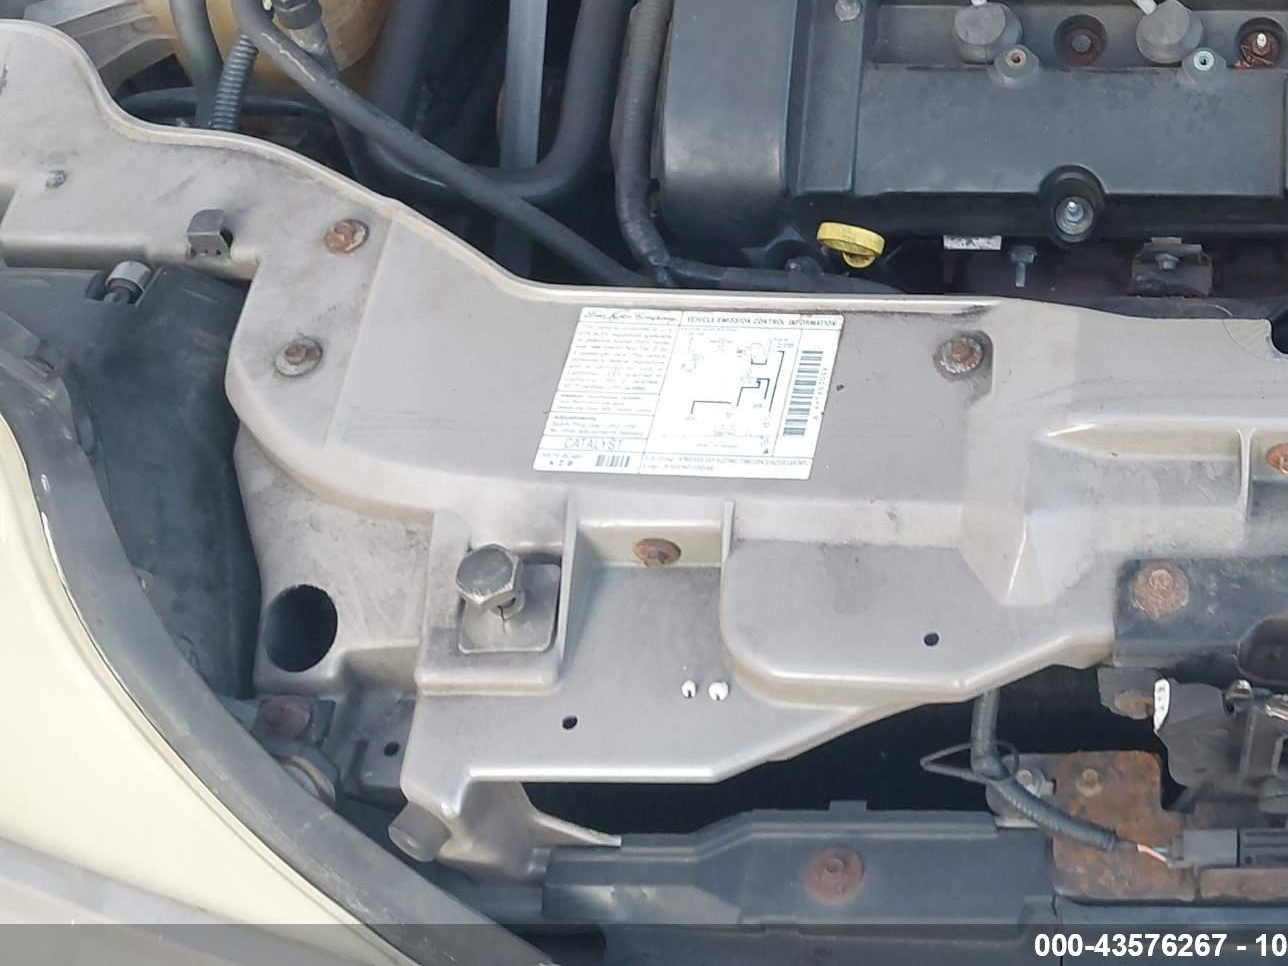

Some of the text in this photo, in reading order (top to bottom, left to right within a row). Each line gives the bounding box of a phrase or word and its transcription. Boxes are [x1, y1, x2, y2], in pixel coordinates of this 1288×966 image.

[687, 316, 715, 324] VEHICLE
[753, 318, 785, 326] CONTROL
[564, 437, 622, 451] CATALYST
